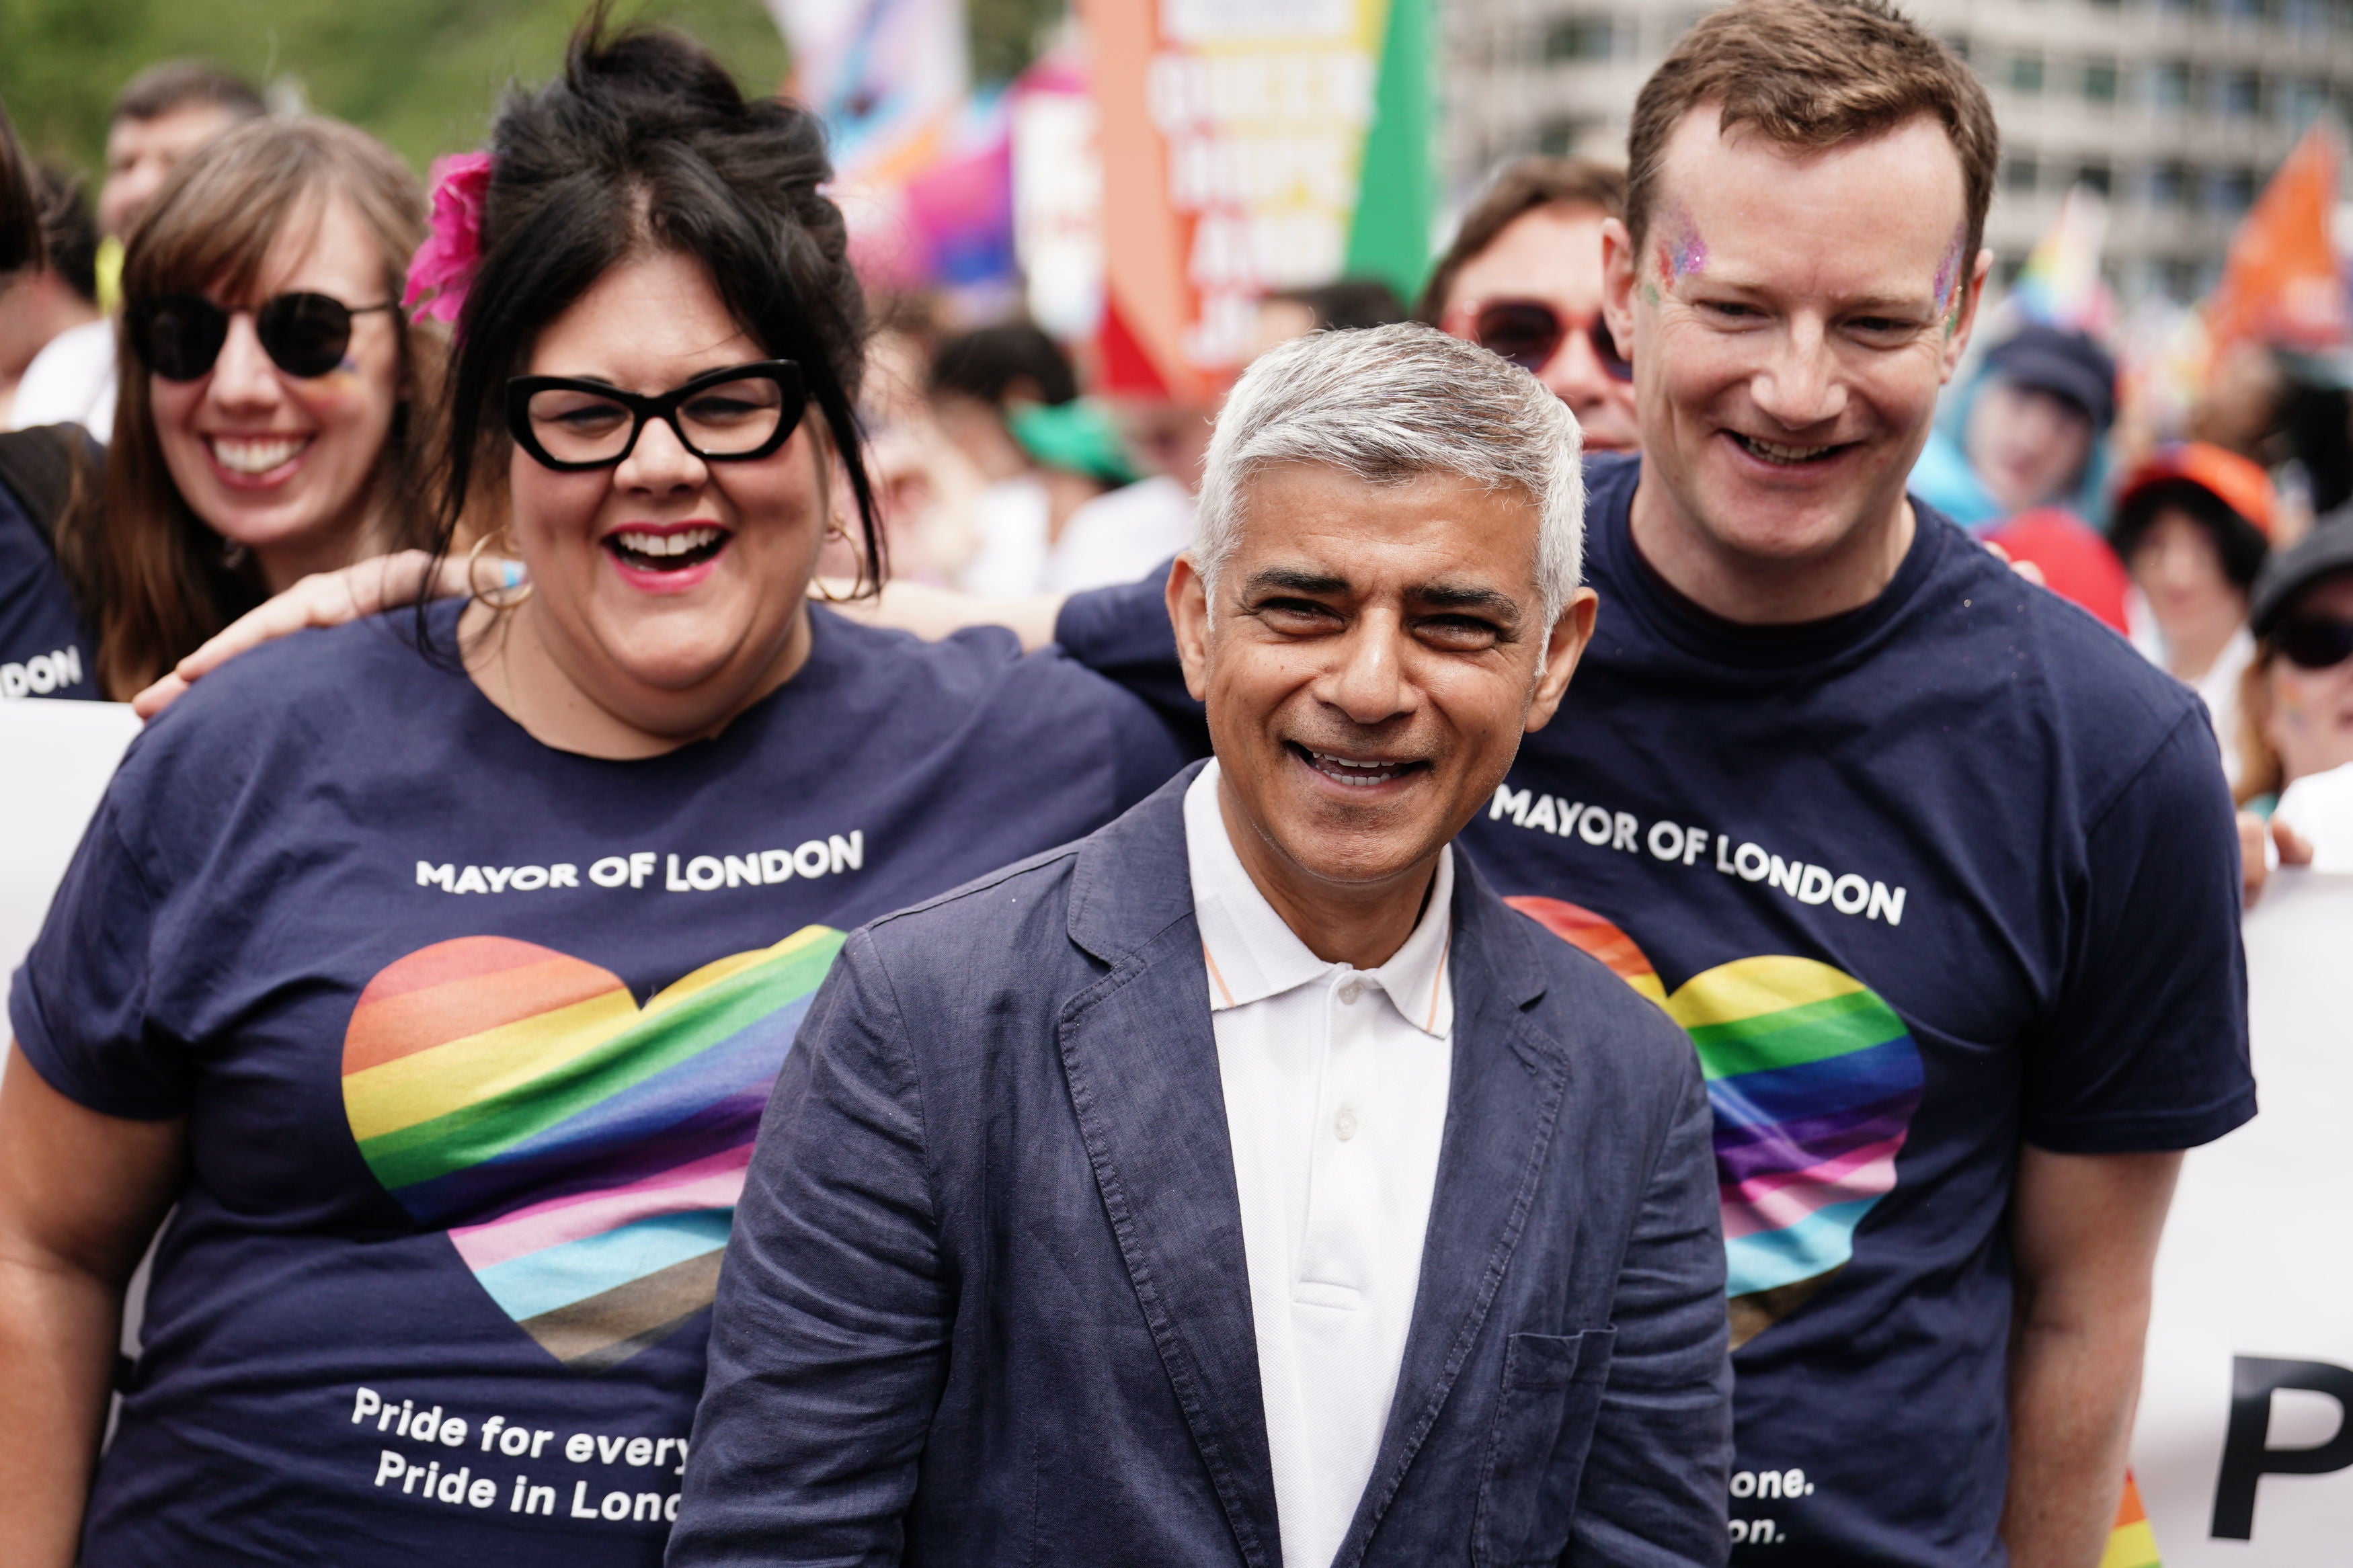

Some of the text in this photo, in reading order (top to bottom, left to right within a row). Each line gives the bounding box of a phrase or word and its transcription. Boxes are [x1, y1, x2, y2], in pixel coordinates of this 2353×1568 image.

[0, 645, 83, 697] DON
[415, 829, 863, 895] MAYOR OF LONDON
[1488, 784, 1907, 925] MAYOR OF LONDON
[351, 1387, 469, 1446] Pride
[480, 1415, 555, 1458] for
[374, 1449, 497, 1509] Pride
[509, 1475, 557, 1516] in
[1729, 1468, 1814, 1499] one.
[1727, 1519, 1786, 1544] on.
